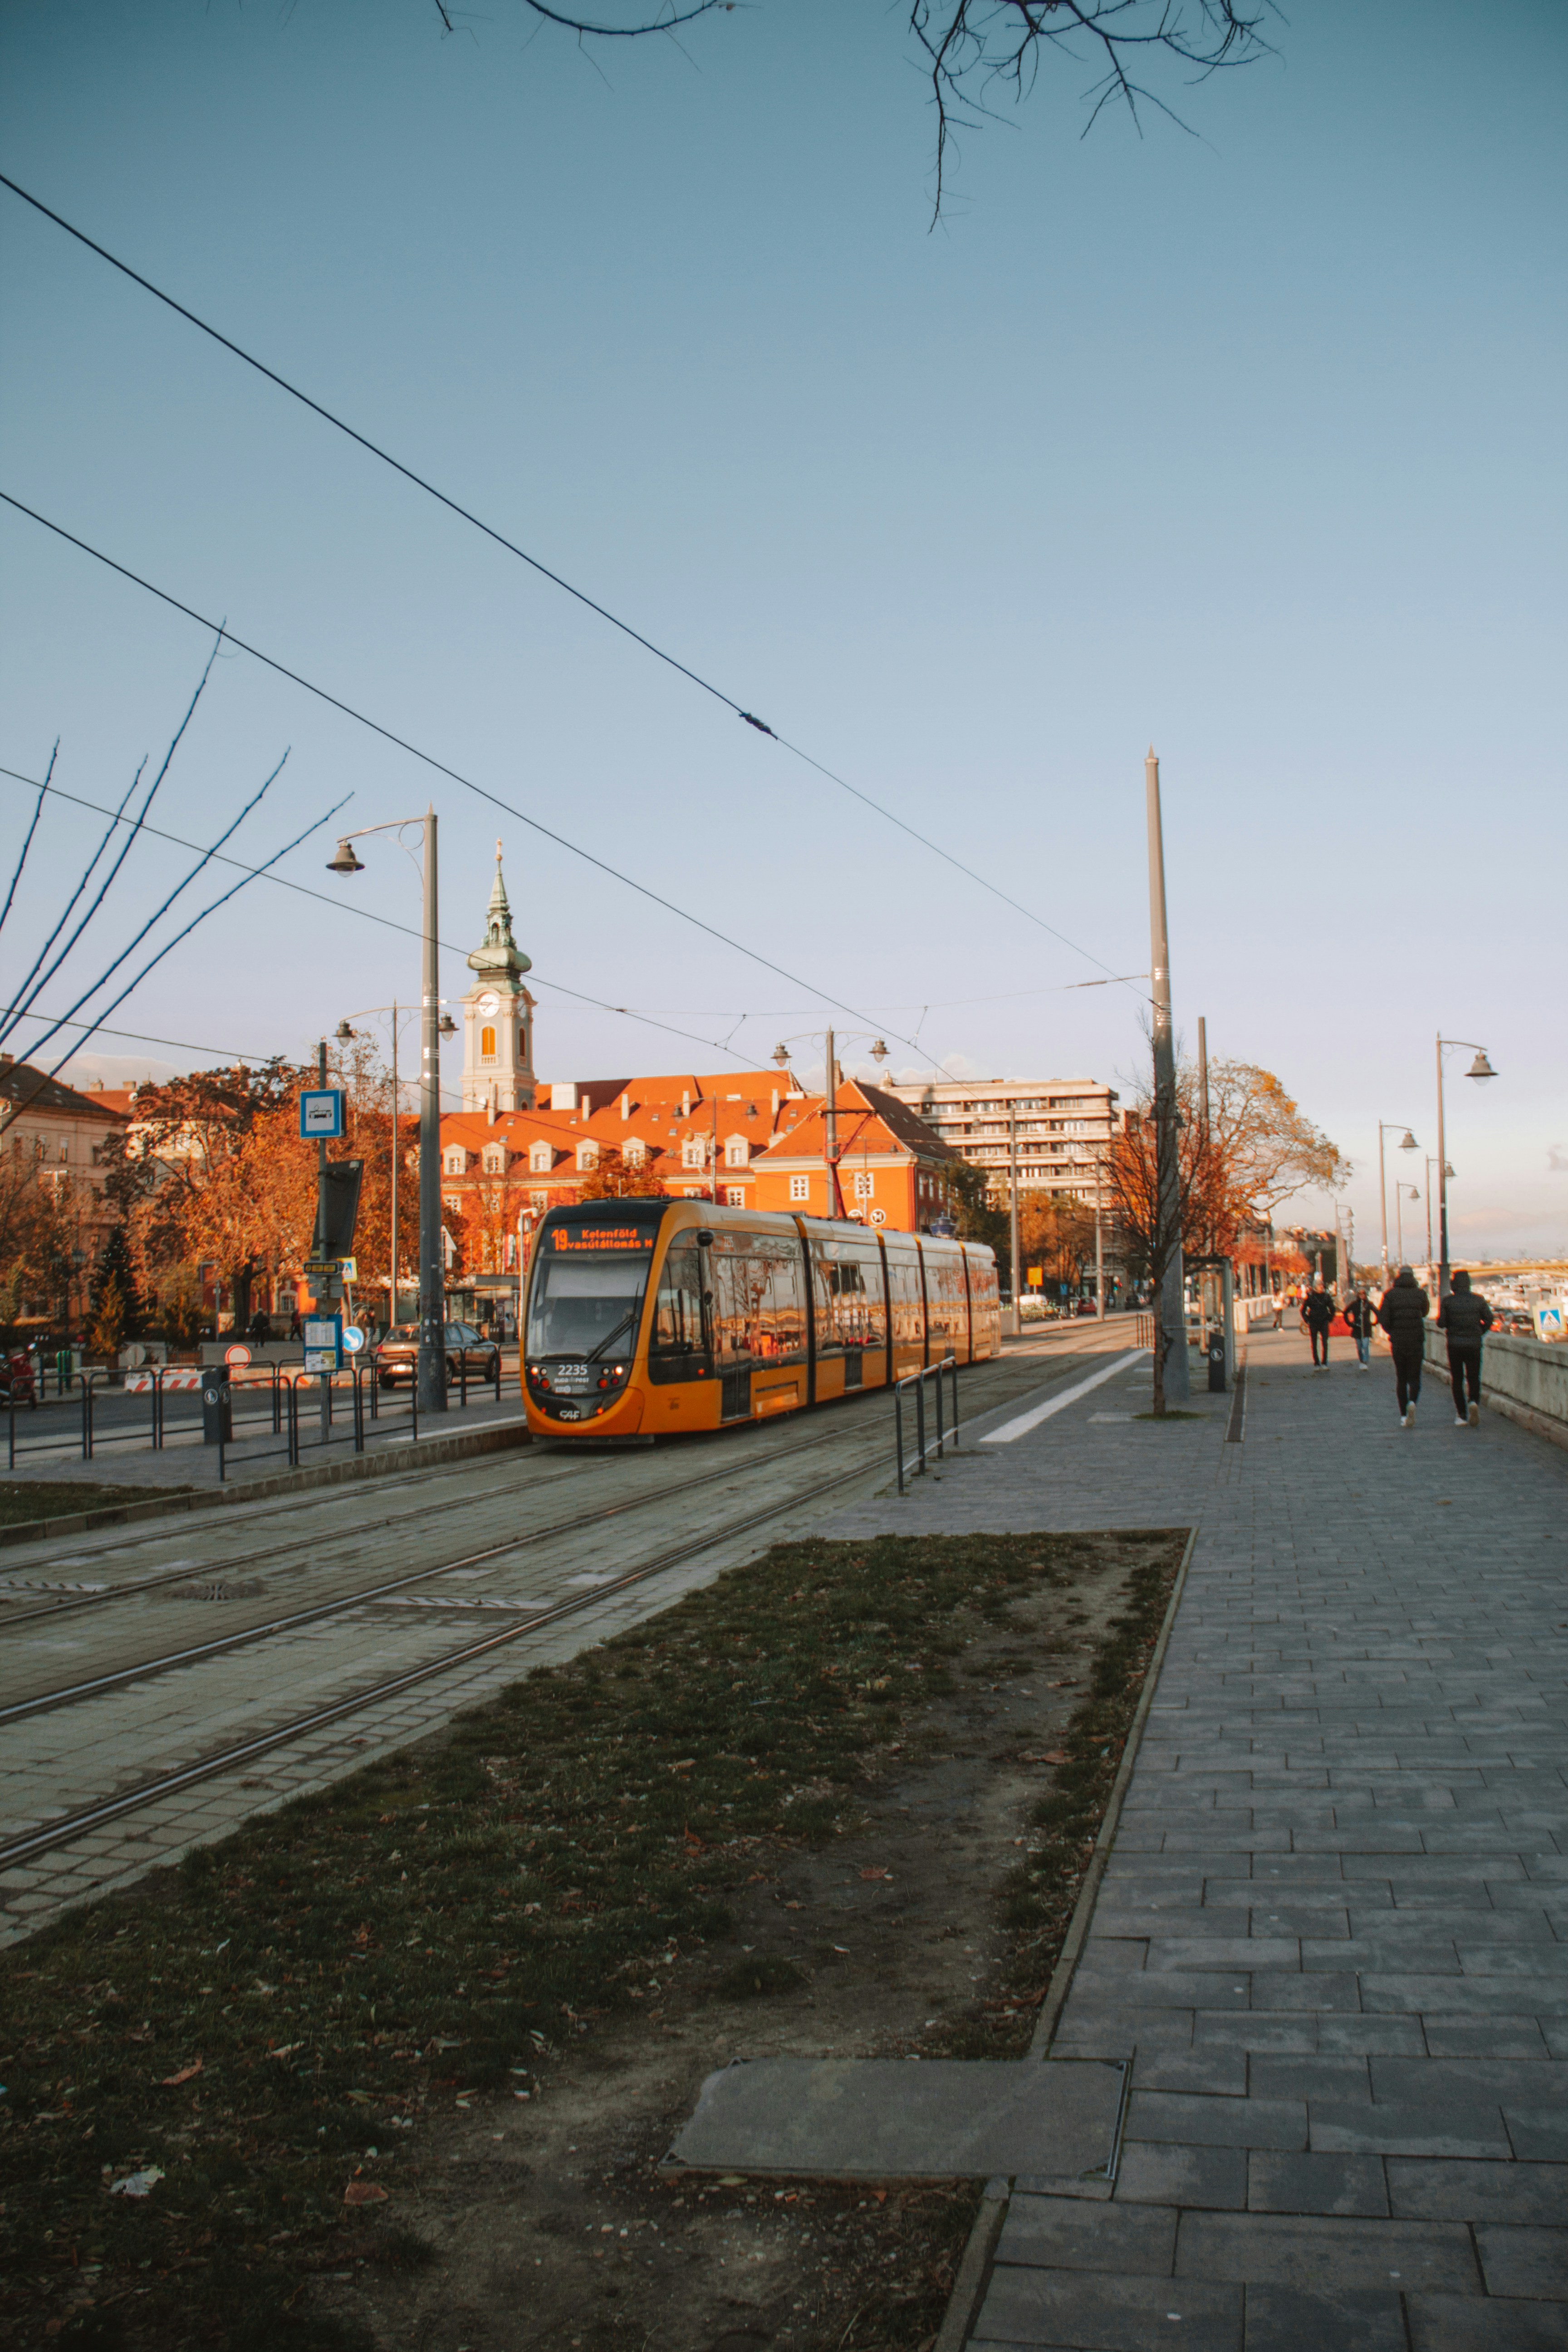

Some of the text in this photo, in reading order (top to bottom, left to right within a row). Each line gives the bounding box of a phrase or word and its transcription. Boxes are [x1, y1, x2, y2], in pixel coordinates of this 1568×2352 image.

[582, 1229, 637, 1239] Kelenföld
[552, 1229, 567, 1251] 19
[568, 1239, 642, 1250] vasútállomás
[558, 1364, 588, 1376] 2235
